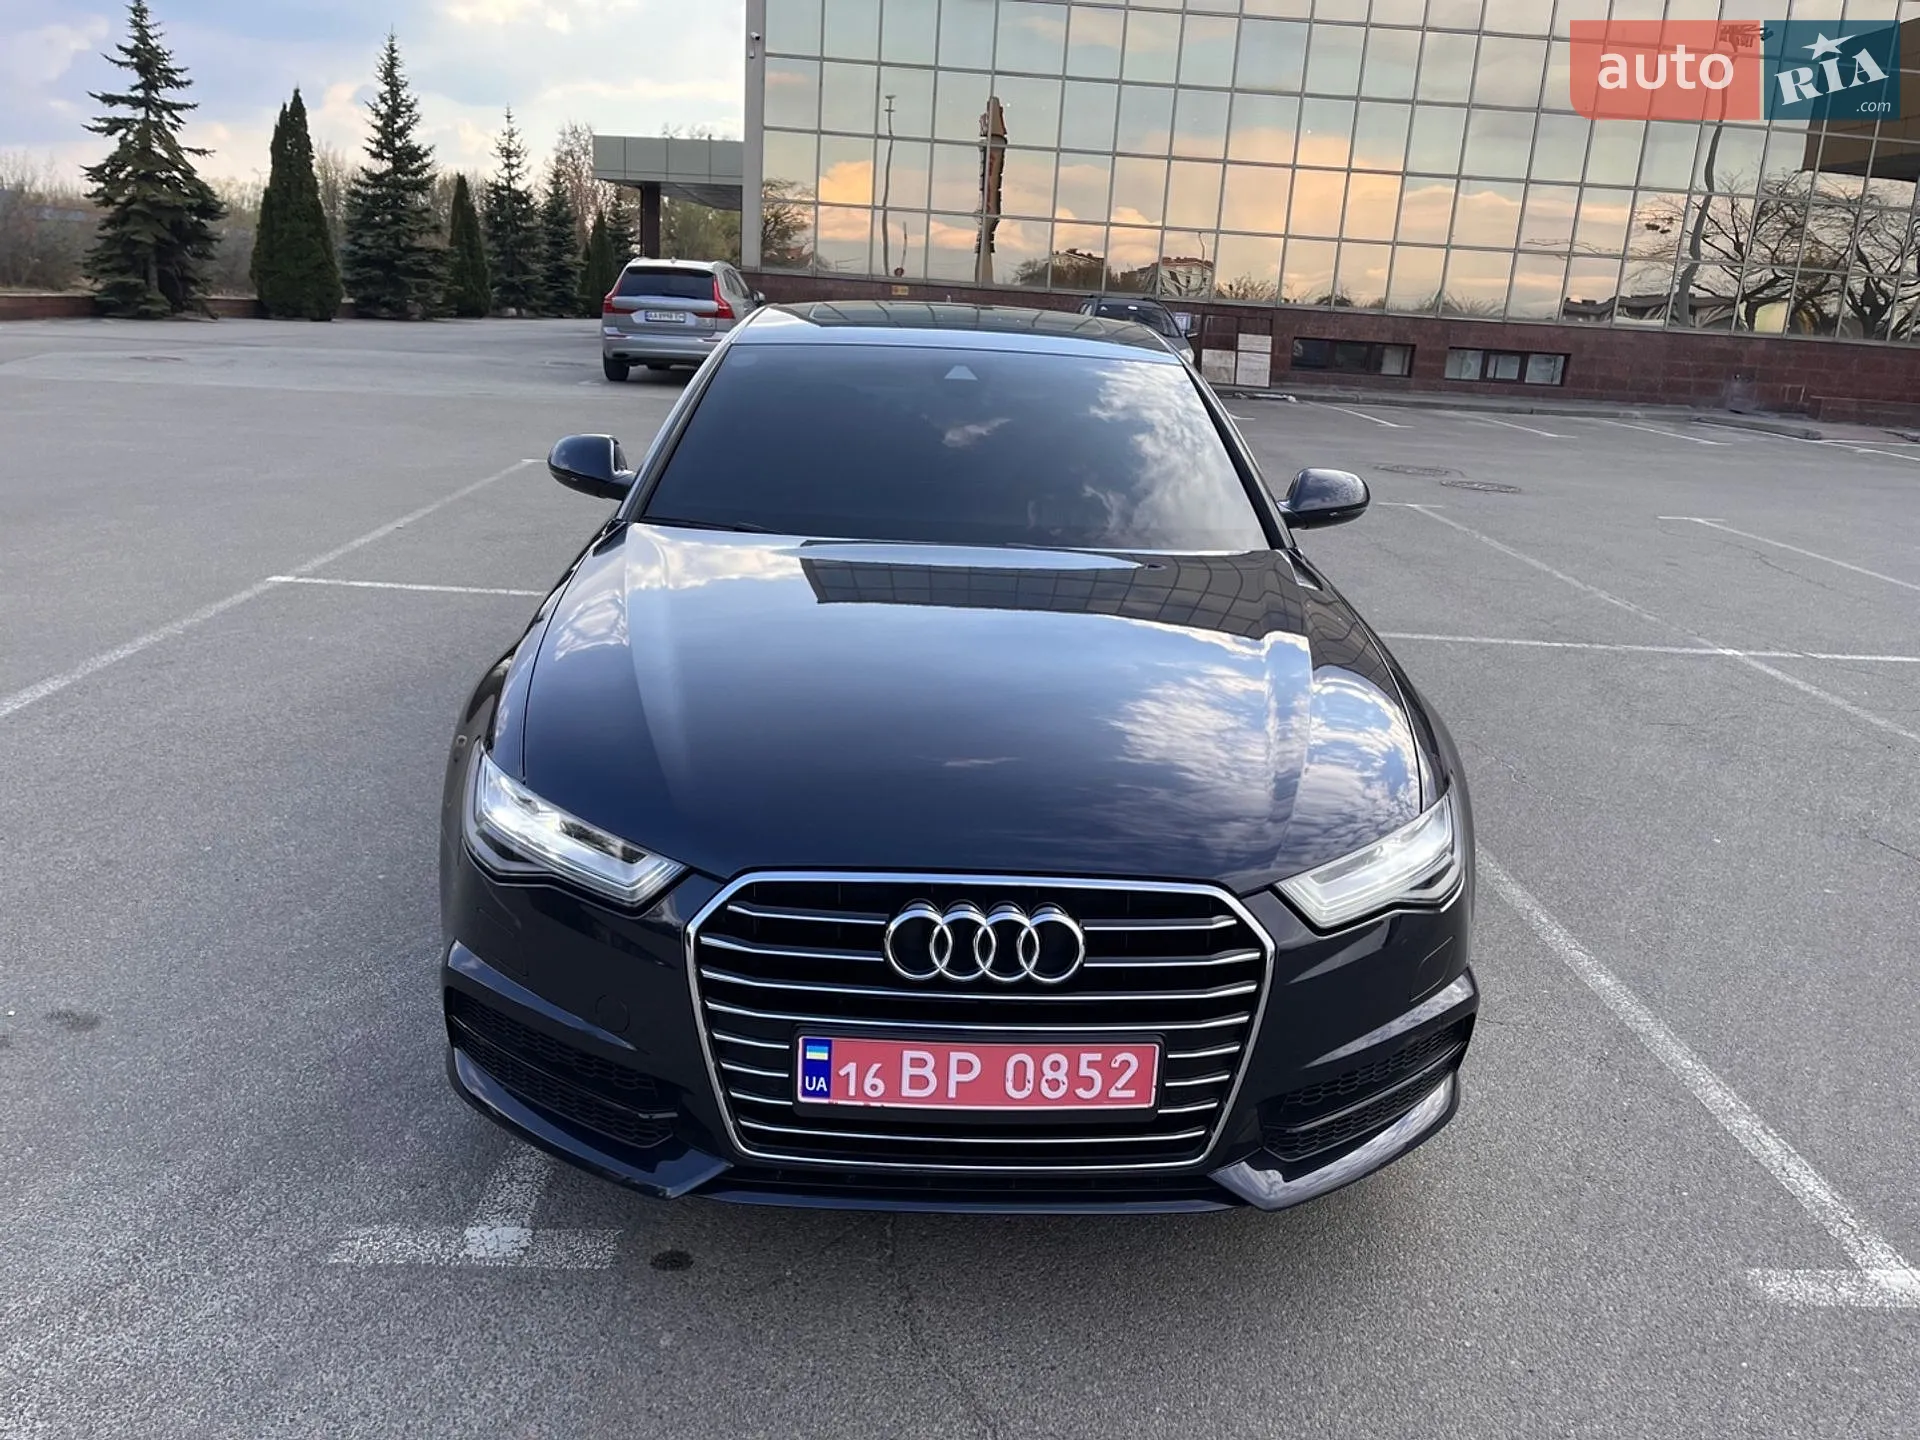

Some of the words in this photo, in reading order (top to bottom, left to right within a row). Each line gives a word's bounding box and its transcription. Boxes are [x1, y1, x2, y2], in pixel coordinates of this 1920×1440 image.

[805, 1076, 828, 1093] UA
[838, 1062, 886, 1098] 16
[900, 1050, 982, 1099] BP
[1005, 1052, 1140, 1100] 0852
